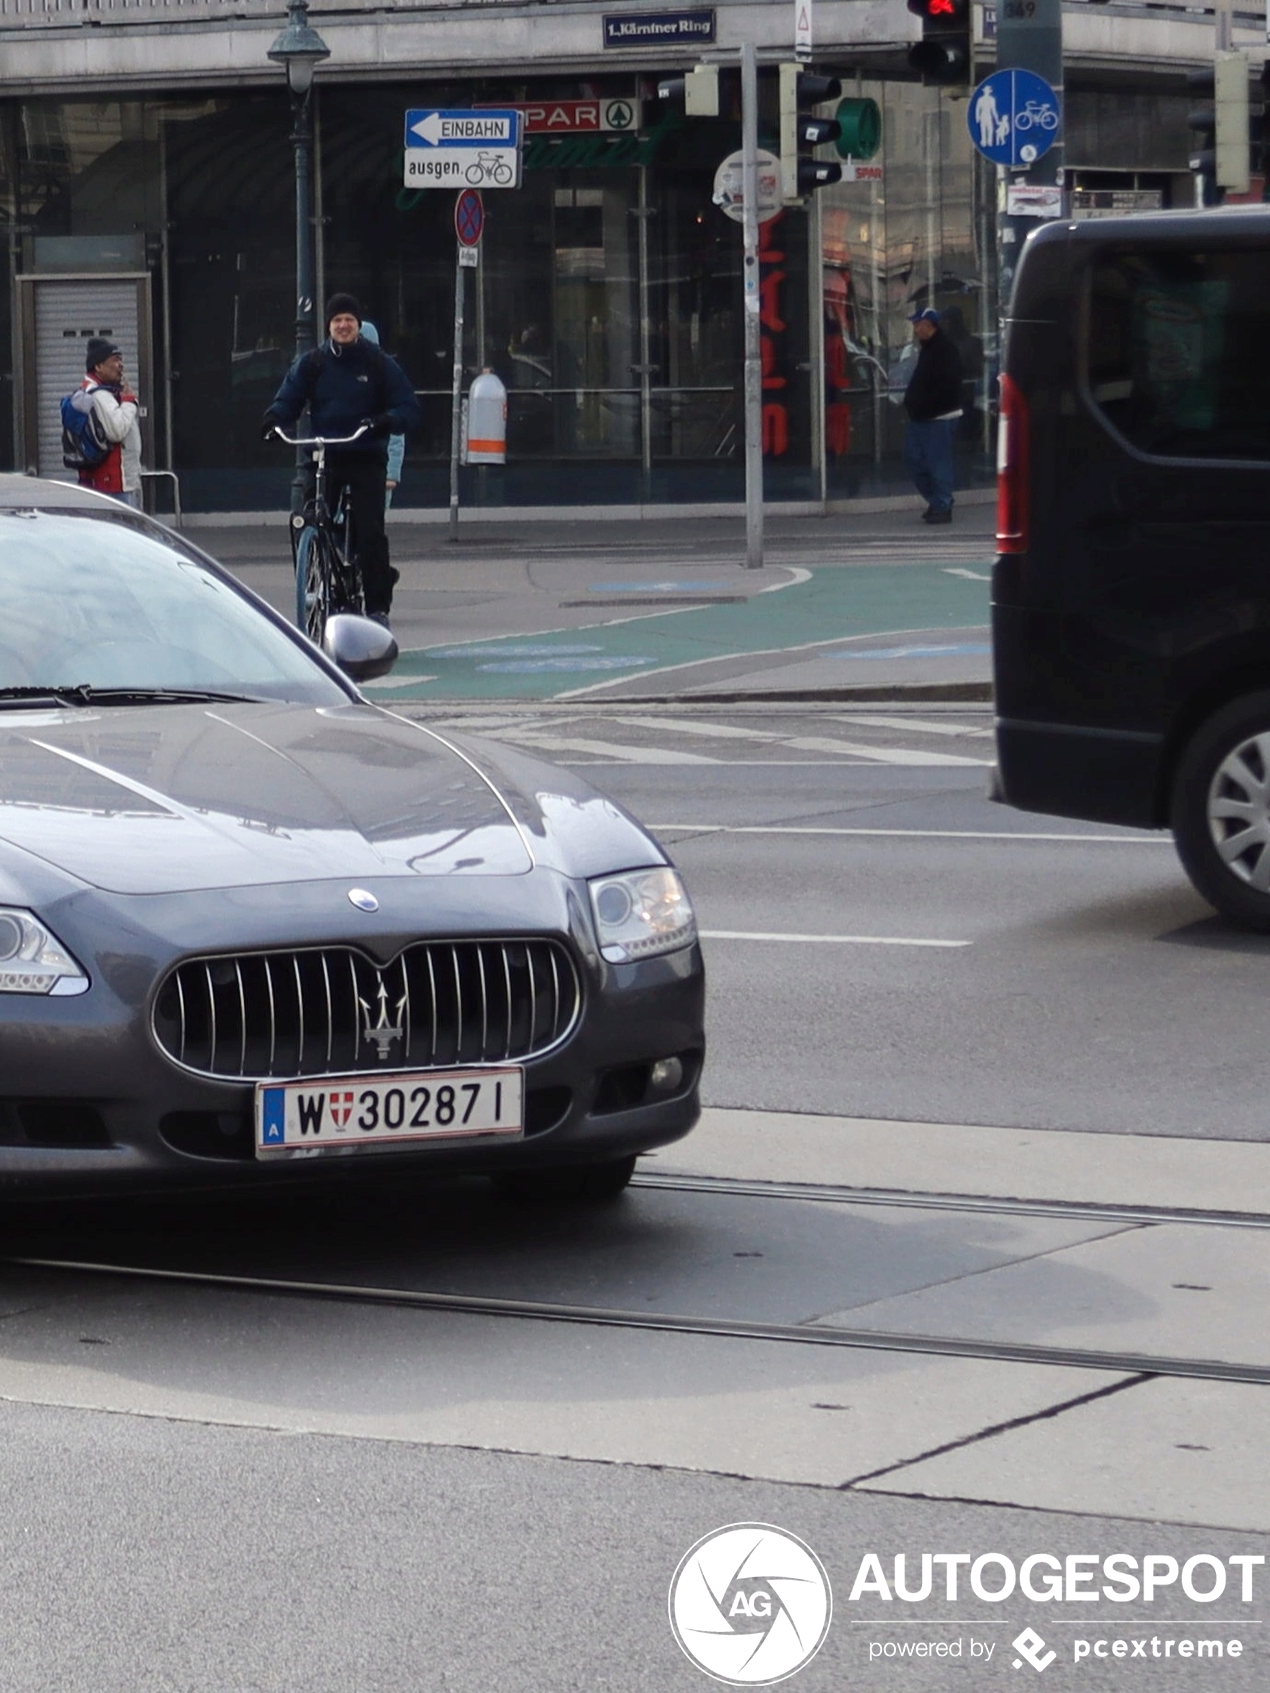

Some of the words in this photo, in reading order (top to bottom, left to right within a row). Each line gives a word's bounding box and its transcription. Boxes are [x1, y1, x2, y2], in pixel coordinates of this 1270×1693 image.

[678, 20, 711, 33] Ring
[524, 106, 597, 128] PAR
[441, 120, 505, 138] EINBAHN
[408, 160, 465, 179] ausgen.
[855, 167, 883, 179] SPAR
[297, 1092, 325, 1136] W
[268, 1123, 279, 1137] A
